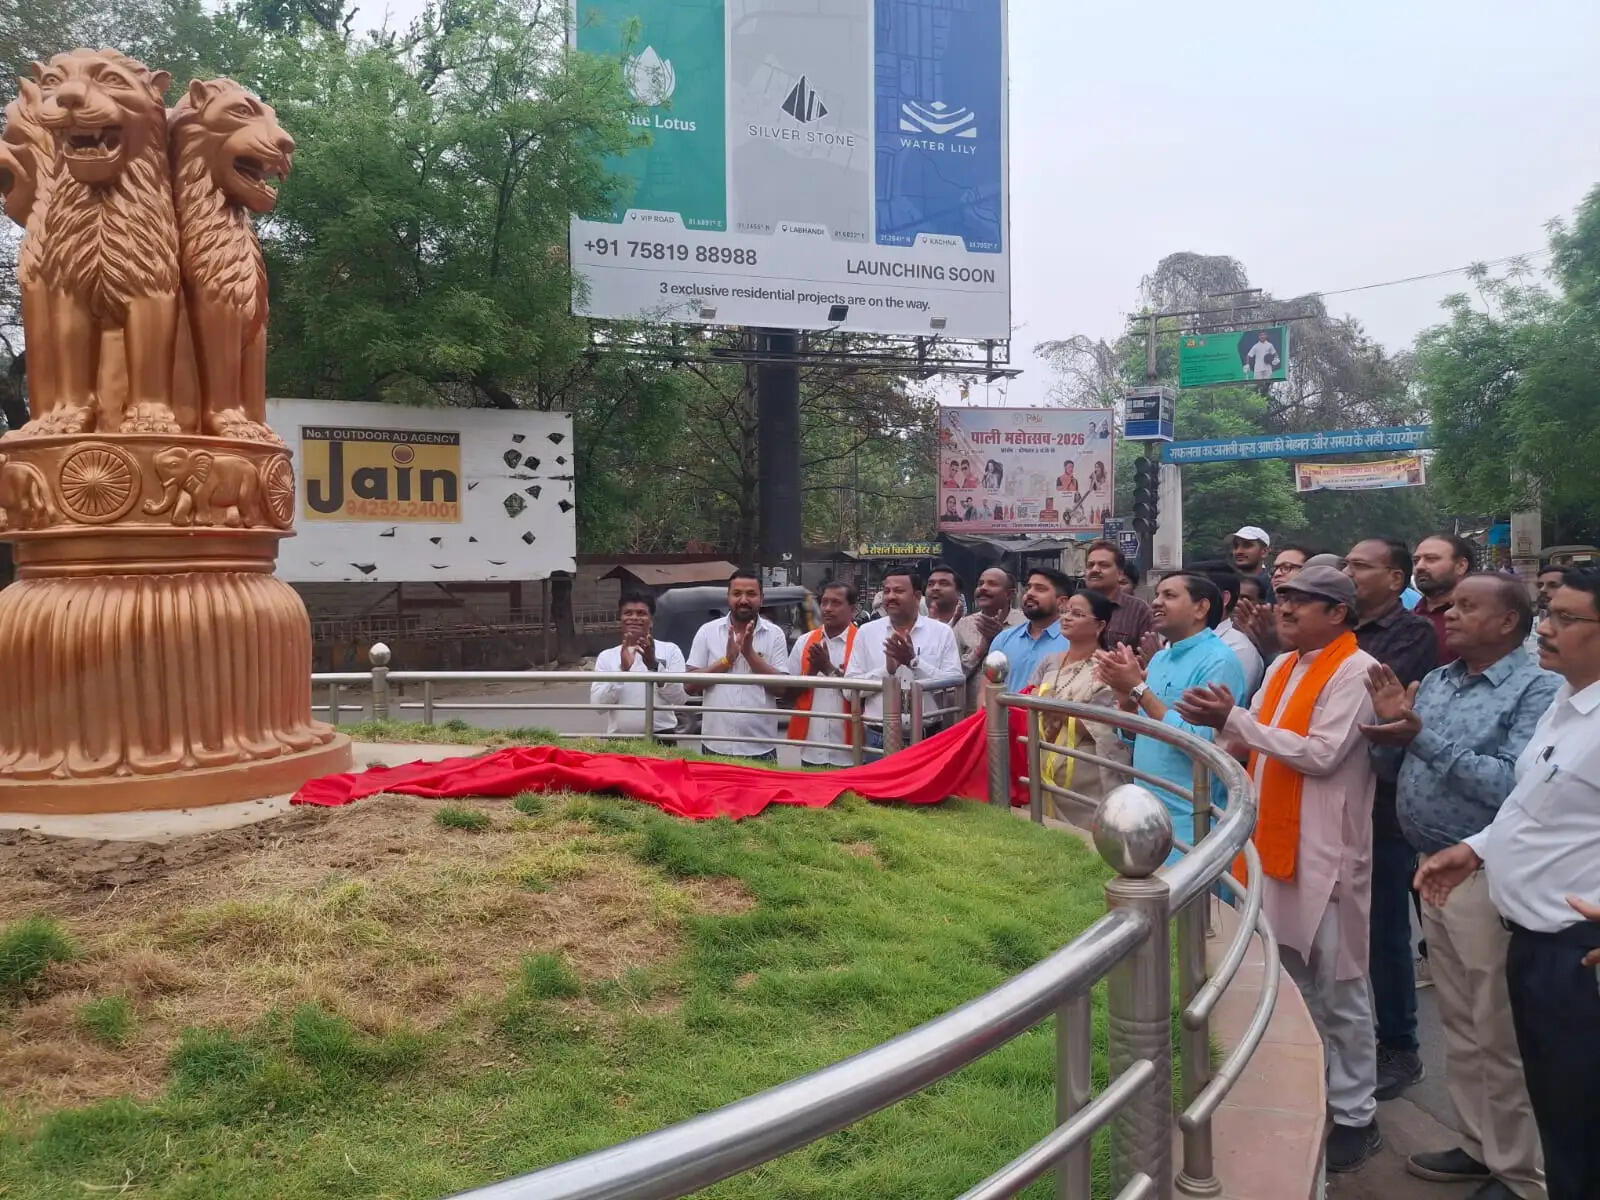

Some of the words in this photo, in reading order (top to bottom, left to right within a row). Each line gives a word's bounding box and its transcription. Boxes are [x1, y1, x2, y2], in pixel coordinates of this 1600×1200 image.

[655, 115, 697, 131] Lotus
[748, 125, 800, 141] SILVER
[807, 131, 855, 147] STONE
[901, 138, 945, 151] WATER
[951, 143, 977, 155] LILY
[640, 214, 653, 222] VIP
[654, 215, 675, 224] ROAD
[584, 238, 618, 256] +91
[627, 241, 689, 261] 75819
[696, 245, 757, 266] 88988
[847, 259, 945, 280] LAUNCHING
[948, 266, 995, 283] SOON
[660, 282, 668, 294] 3
[670, 283, 729, 296] exclusive
[731, 287, 795, 301] residential
[797, 291, 846, 305] projects
[848, 295, 865, 305] are
[868, 298, 883, 307] on
[885, 296, 904, 308] the
[906, 300, 931, 311] way.
[306, 428, 329, 439] No.1
[333, 430, 390, 441] OUTDOOR
[393, 433, 408, 442] AD
[411, 434, 456, 444] AGENCY
[971, 428, 1001, 445] पाली
[1258, 437, 1285, 453] आपकी
[1311, 432, 1329, 449] और
[1354, 430, 1364, 447] के
[307, 441, 458, 513] Jain
